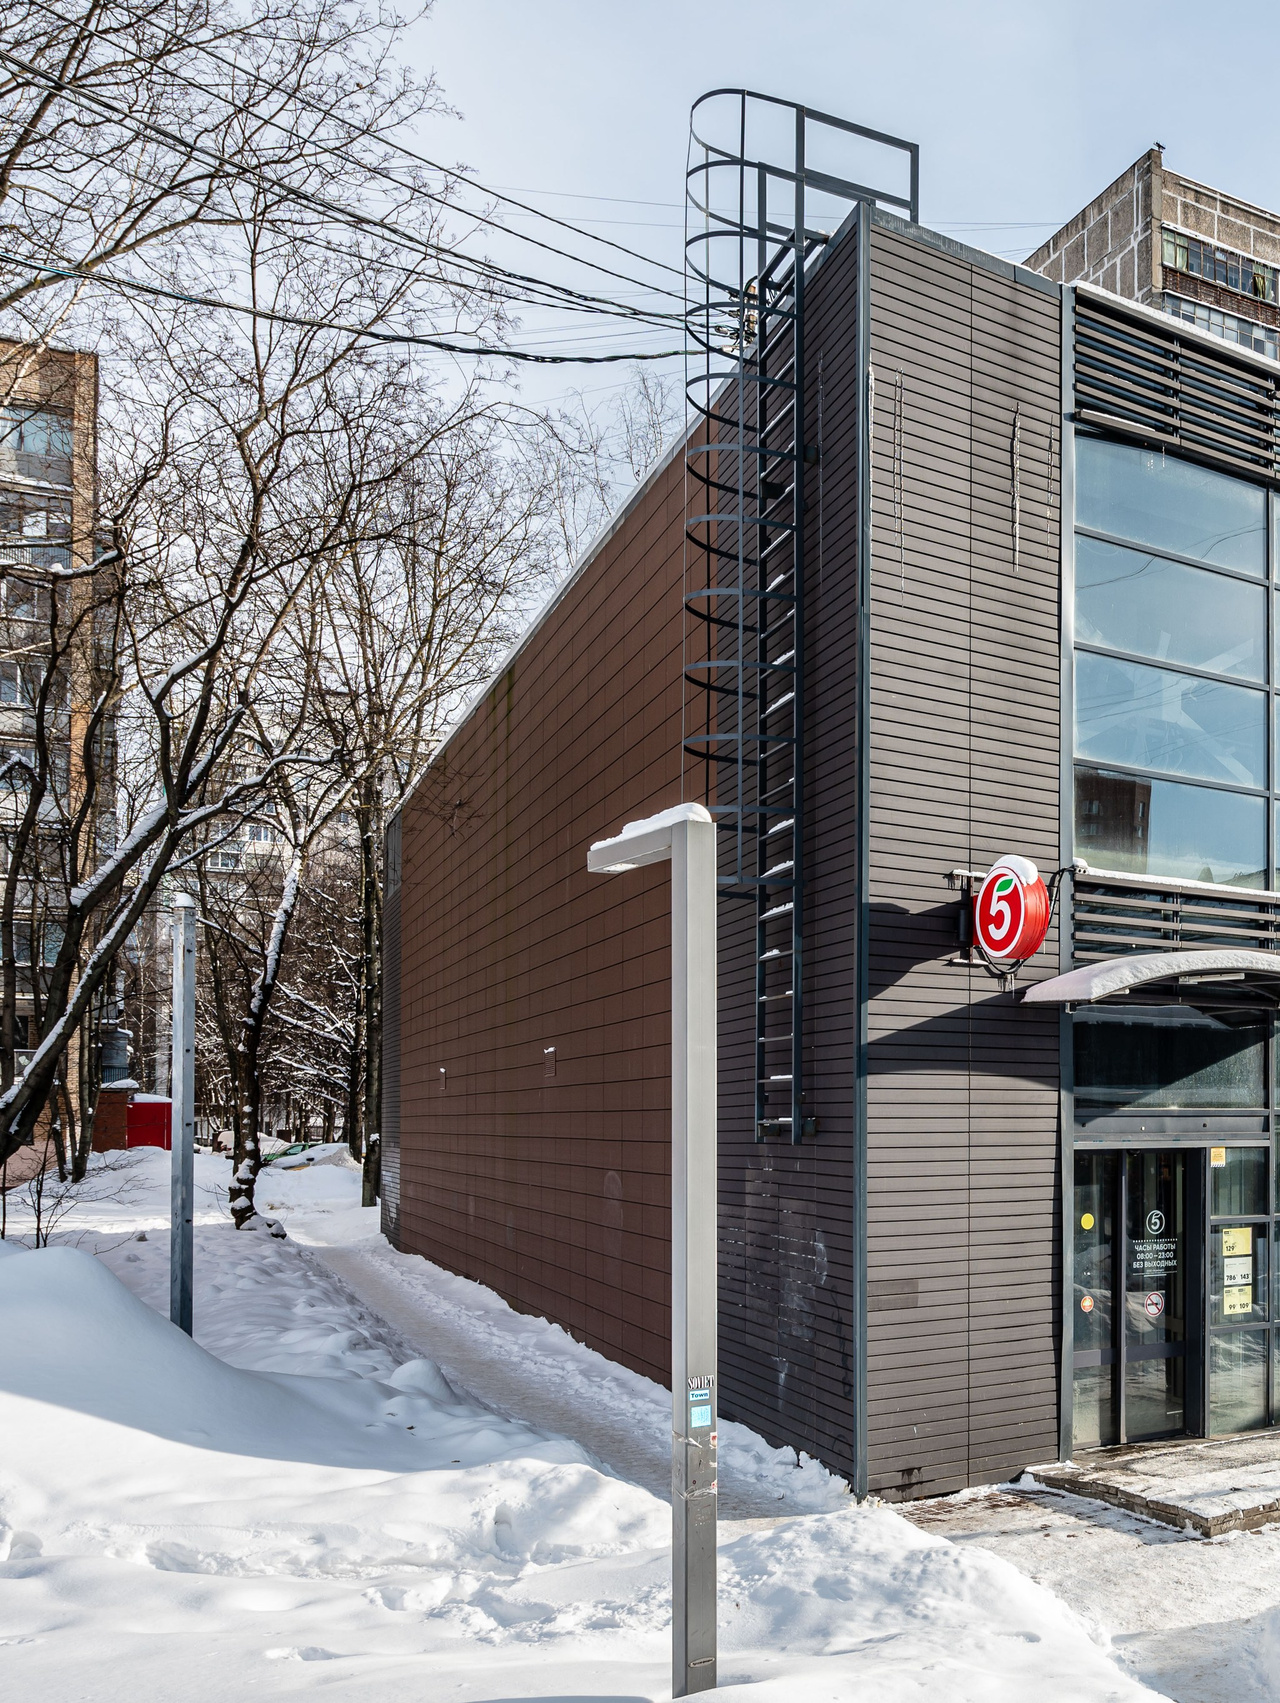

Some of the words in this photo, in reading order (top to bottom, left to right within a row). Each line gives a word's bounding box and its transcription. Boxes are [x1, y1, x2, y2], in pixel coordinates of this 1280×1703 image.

[988, 875, 1015, 940] 5
[1133, 1261, 1144, 1269] БЕЗ
[1144, 1260, 1177, 1268] ВЫХОДНЫХ
[688, 1375, 714, 1389] SOVIET
